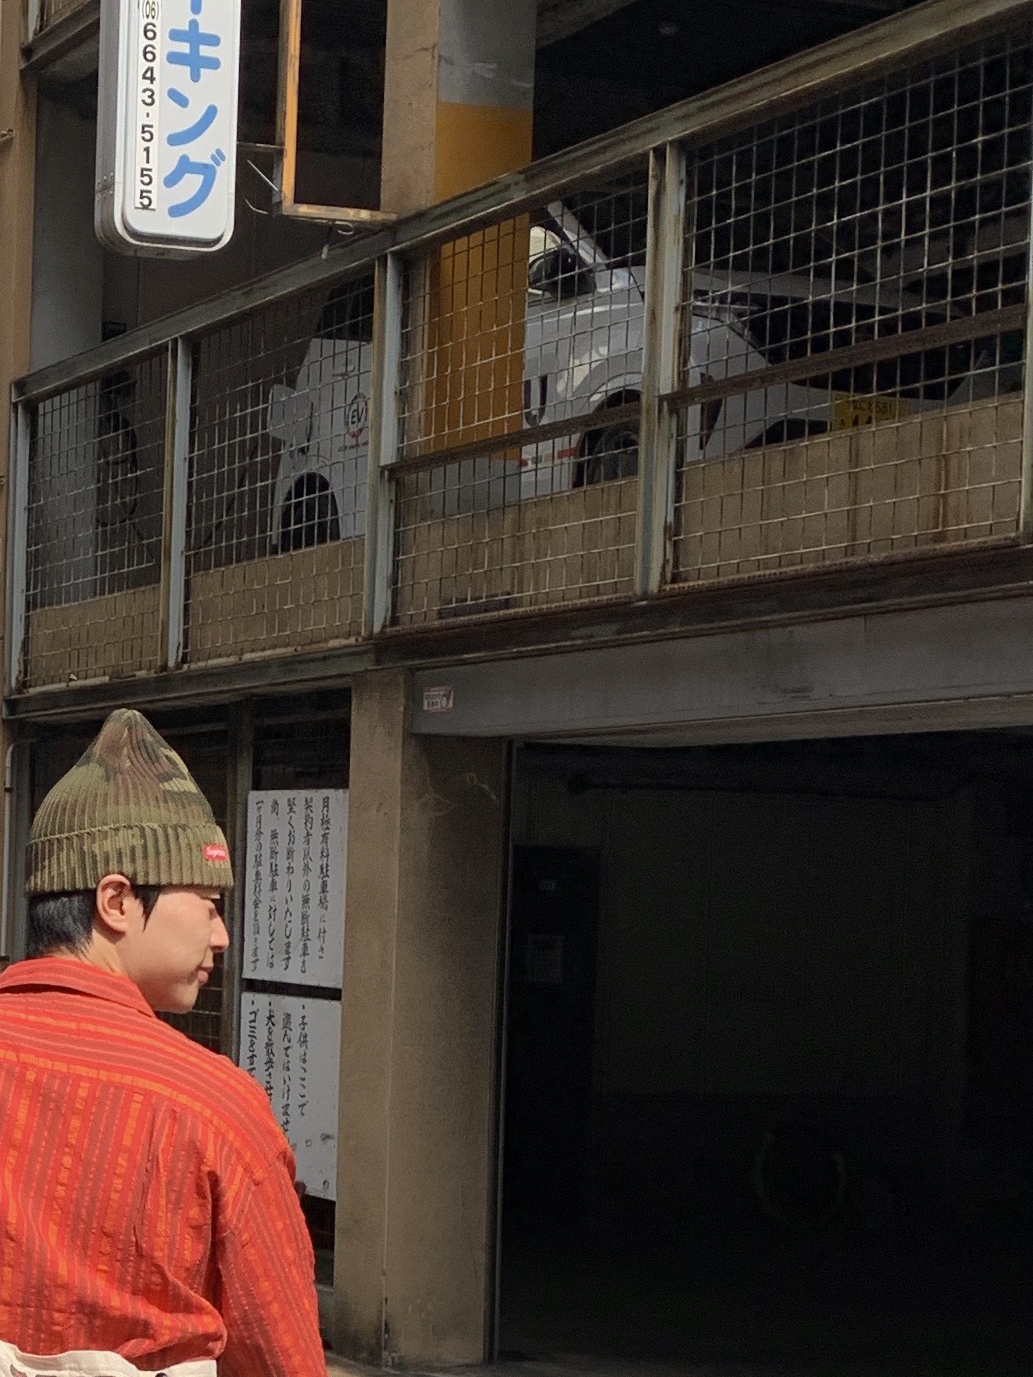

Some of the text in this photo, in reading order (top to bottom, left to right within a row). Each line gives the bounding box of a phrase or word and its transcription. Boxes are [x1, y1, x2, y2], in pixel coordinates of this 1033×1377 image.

[164, 0, 226, 218] キング
[281, 1012, 294, 1147] 遊んではいけませ
